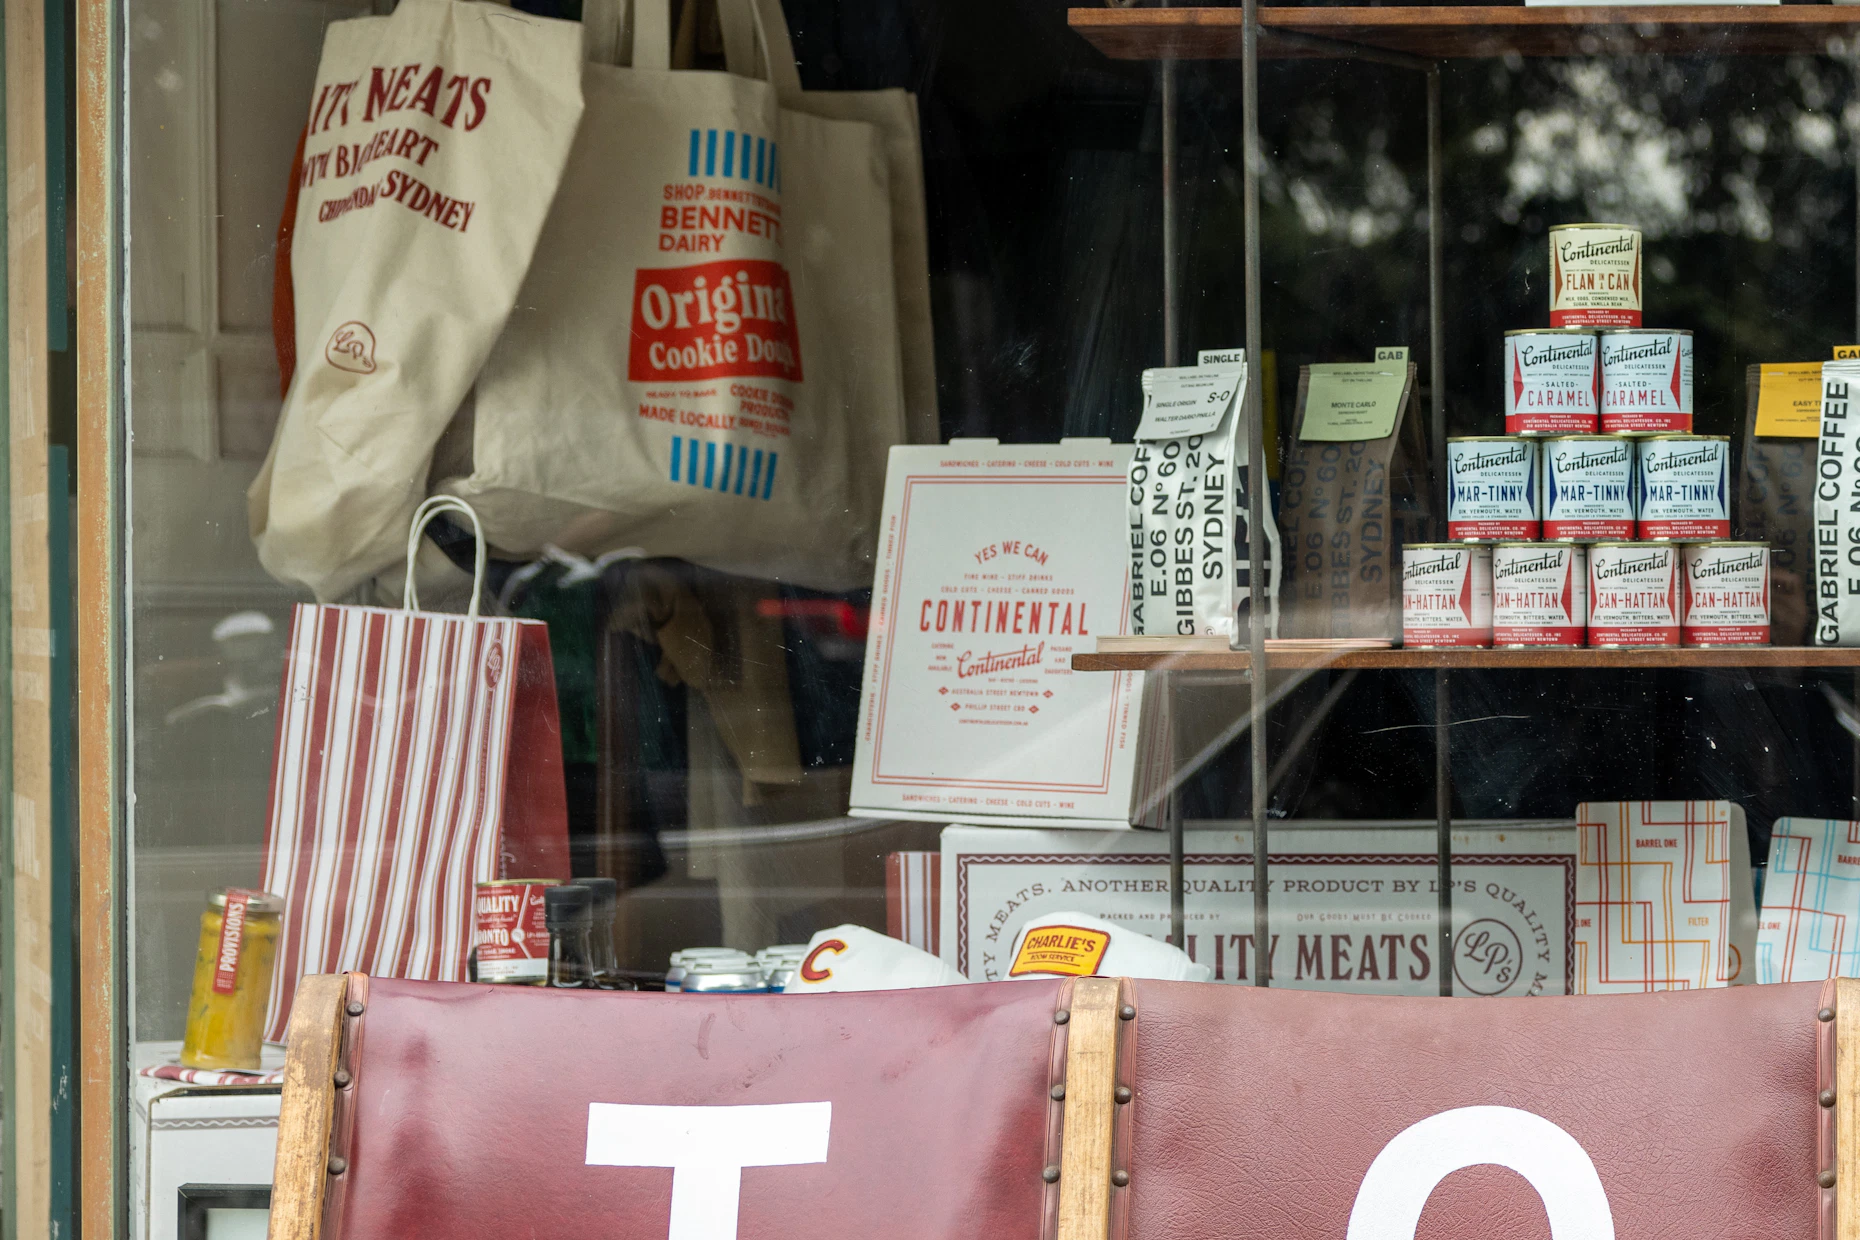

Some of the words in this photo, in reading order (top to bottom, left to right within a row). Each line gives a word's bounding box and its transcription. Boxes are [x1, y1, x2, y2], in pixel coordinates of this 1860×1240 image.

[380, 169, 475, 233] SYDNEY
[663, 184, 705, 201] SHOP
[658, 234, 724, 252] DAIRY
[1561, 234, 1634, 263] Continental
[1566, 273, 1595, 290] FLAN
[1608, 273, 1629, 291] CAN
[650, 334, 738, 371] Cookie
[1203, 354, 1241, 365] SINGLE
[1377, 350, 1403, 361] GAB
[1522, 338, 1593, 367] Continental
[1602, 337, 1673, 367] Continental
[1207, 390, 1231, 404] S-O
[1528, 390, 1590, 407] CARAMEL
[1606, 389, 1666, 406] CARAMEL
[639, 403, 675, 423] MADE
[1819, 382, 1849, 502] COFFEE
[1024, 460, 1047, 468] CHEESE
[1055, 460, 1071, 468] COLD
[1073, 460, 1090, 468] CUTS
[1454, 444, 1528, 474] Continental
[1555, 444, 1629, 474] Continental
[1645, 443, 1719, 474] Continental
[1458, 485, 1523, 502] MAR-TINNY
[1560, 484, 1626, 501] MAR-TINNY
[1650, 484, 1715, 501] MAR-TINNY
[1202, 452, 1225, 580] SYDNEY
[1360, 459, 1385, 584] SYDNEY
[974, 544, 998, 566] YES
[1002, 541, 1022, 556] WE
[1024, 544, 1049, 566] CAN
[1150, 528, 1167, 597] E.06
[1495, 550, 1564, 580] Continental
[1595, 550, 1668, 580] Continental
[1691, 550, 1763, 580] Continental
[1174, 526, 1195, 635] GIBBES
[1818, 509, 1840, 645] GABRIEL
[941, 586, 958, 594] COLD
[960, 586, 978, 594] CUTS
[987, 586, 1012, 595] CHEESE
[1496, 592, 1559, 609] CAN-HATTAN
[1599, 592, 1665, 609] CAN-HATTAN
[1695, 592, 1761, 608] CAN-HATTAN
[920, 599, 1089, 636] CONTINENTAL
[957, 640, 1045, 679] Continental
[1636, 839, 1663, 848] BARREL
[1664, 838, 1678, 848] ONE
[477, 894, 520, 915] QUALITY
[1062, 880, 1170, 893] ANOTHER
[1283, 880, 1384, 893] PRODUCT
[1392, 880, 1420, 893] BY
[1486, 883, 1550, 964] QUALITY
[1297, 912, 1315, 922] OUR
[1319, 912, 1348, 922] GOODS
[1352, 912, 1376, 922] MUST
[1381, 912, 1394, 922] BE
[1397, 912, 1432, 922] COOKED
[1579, 918, 1592, 927] ONE
[1688, 917, 1709, 927] FILTER
[1767, 921, 1781, 930] ONE
[219, 902, 245, 973] PROVISIONS
[1027, 935, 1096, 953] CHARLIE'S
[801, 939, 848, 984] C
[1050, 953, 1075, 962] SERVICE
[1295, 934, 1432, 981] MEATS
[1463, 931, 1512, 983] LP's
